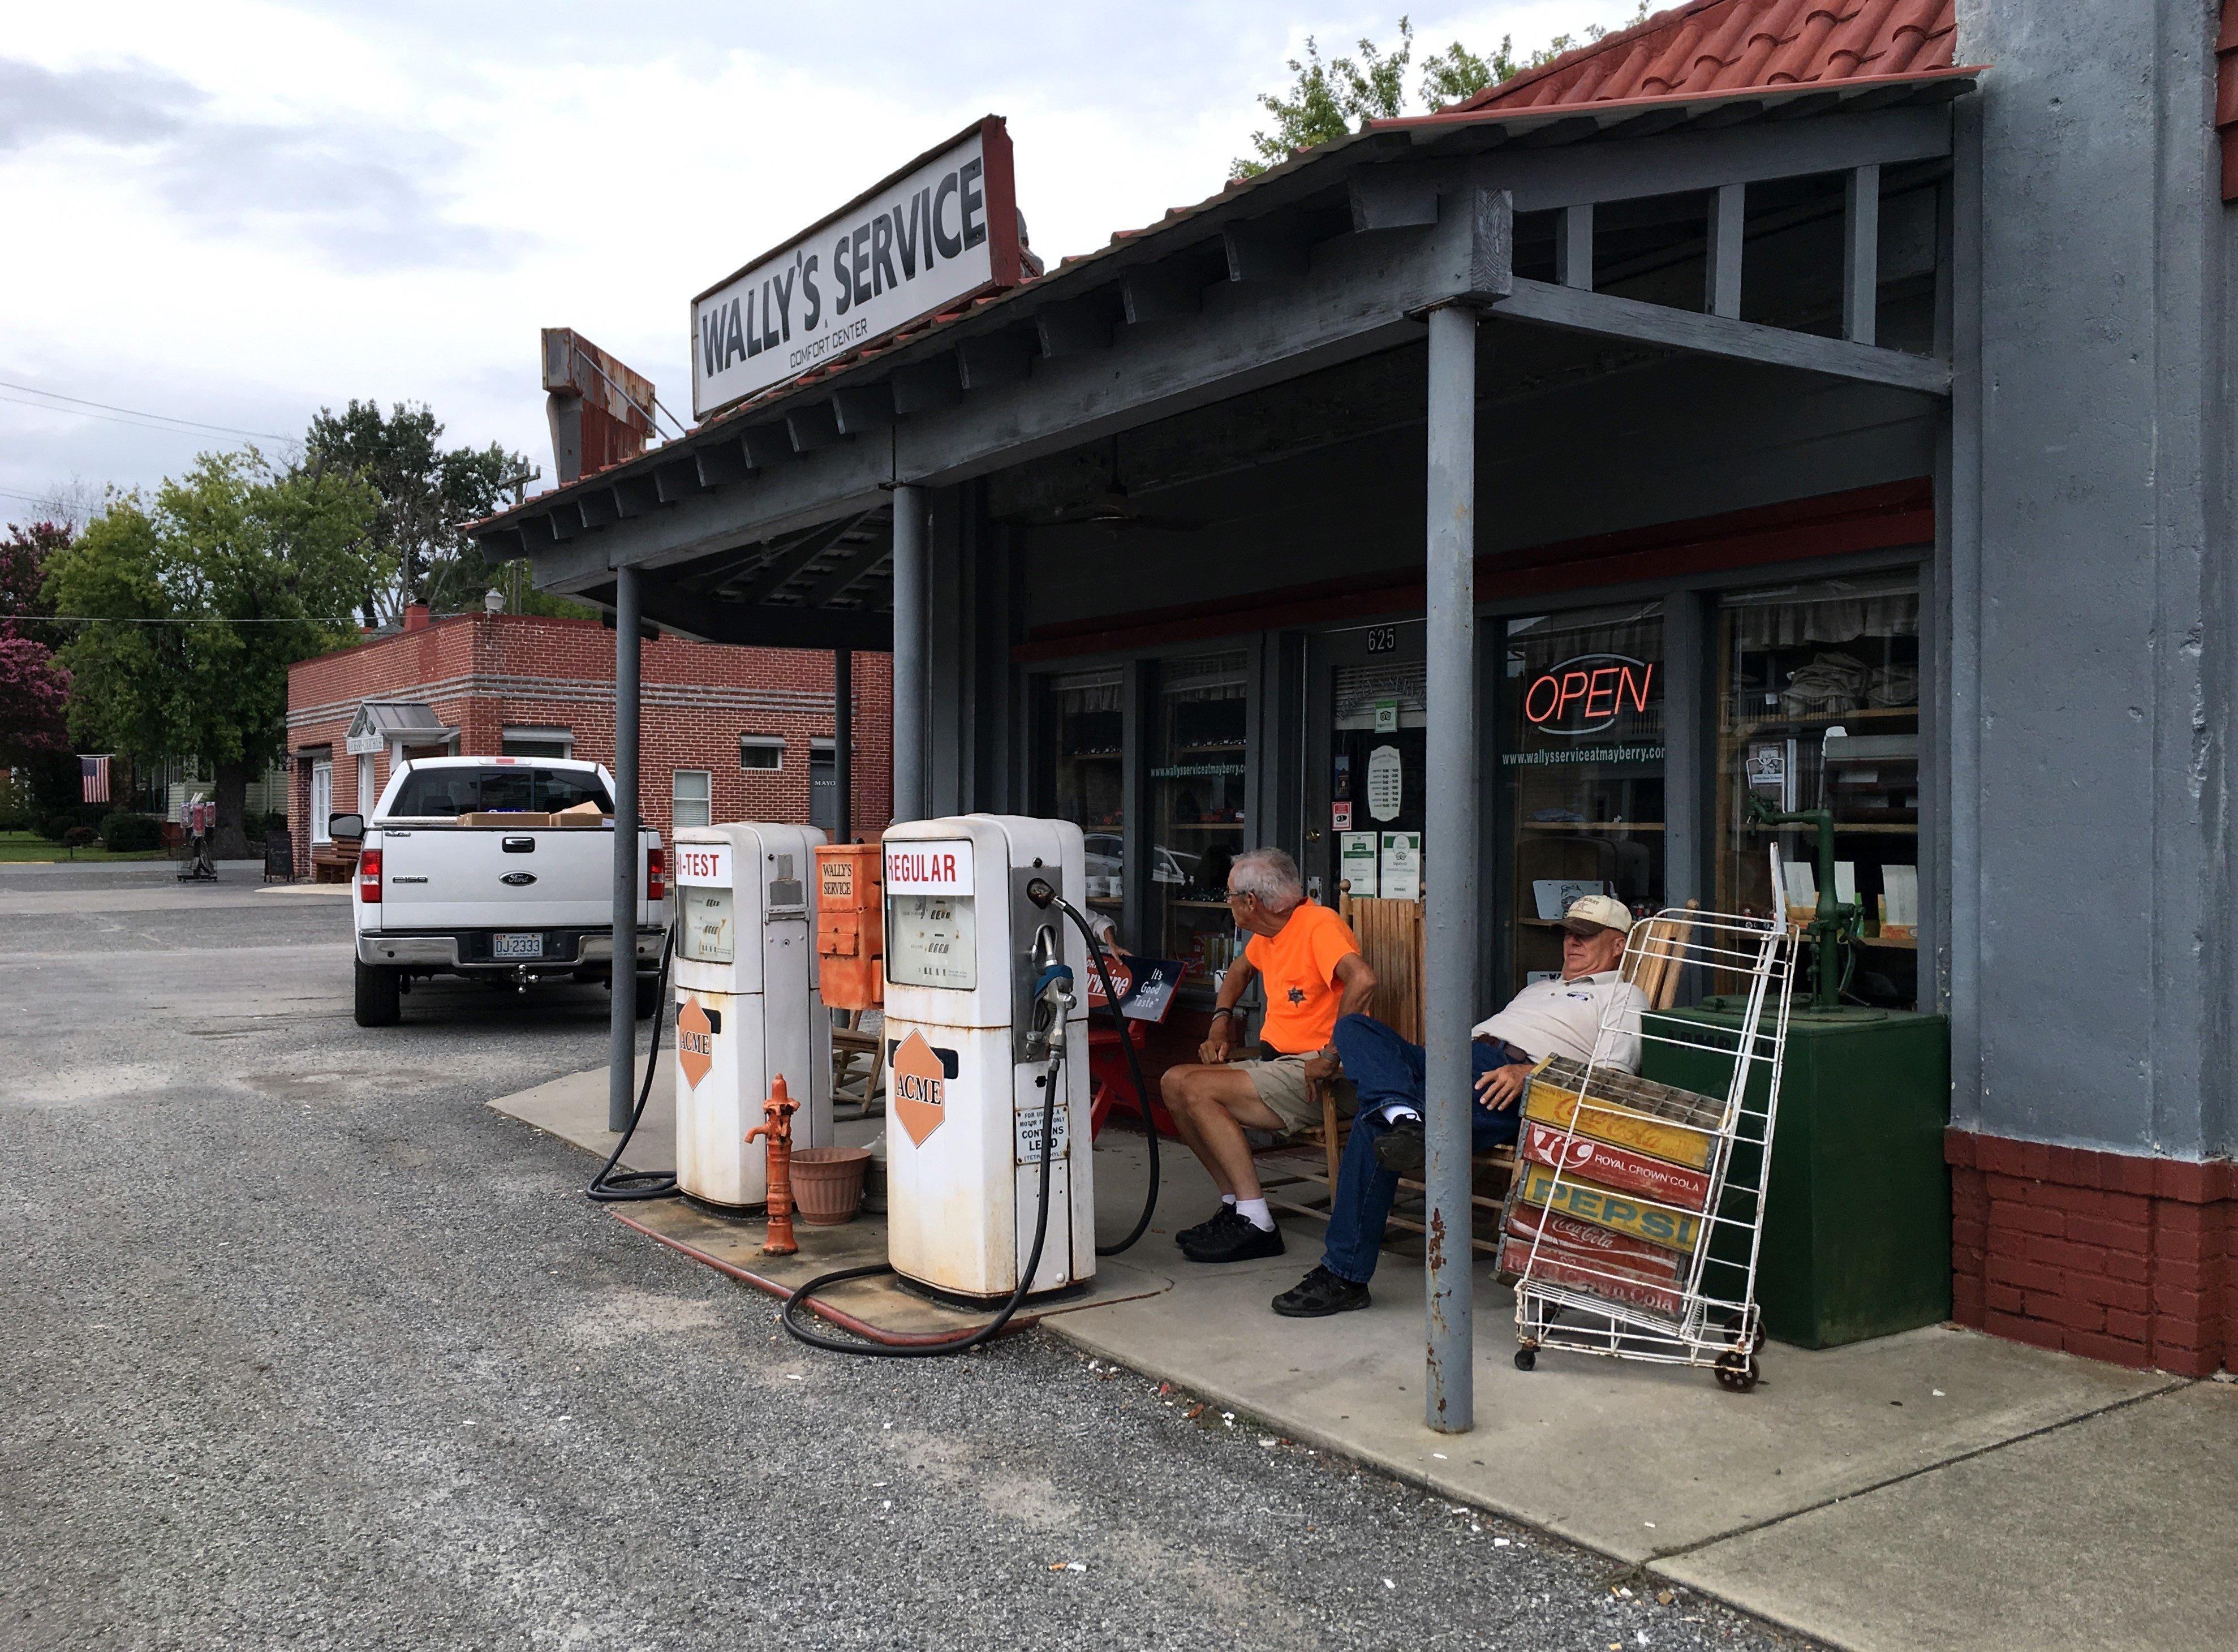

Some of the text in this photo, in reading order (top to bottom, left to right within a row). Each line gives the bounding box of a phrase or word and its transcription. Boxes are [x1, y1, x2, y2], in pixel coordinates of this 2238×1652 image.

[703, 156, 987, 378] WALLY'S SERVICE
[790, 317, 868, 368] COMFORT CENTER
[1368, 628, 1395, 651] 625
[1526, 663, 1653, 723] OPEN
[1151, 762, 1245, 777] www.wallysserviceatmayberry.c
[677, 853, 720, 876] HI-TEST
[823, 863, 852, 877] WALLY'S
[888, 854, 956, 881] REGULAR
[508, 874, 528, 883] Ford
[824, 881, 851, 895] SERVICE
[496, 940, 540, 952] DJ-2333
[1151, 967, 1163, 980] It's
[1140, 981, 1162, 995] Good
[680, 1031, 710, 1055] ACME
[896, 1073, 941, 1105] ACME
[1022, 1126, 1064, 1139] CONTNS
[1029, 1138, 1058, 1151] LED
[1595, 1154, 1699, 1191] ROYAL CROWN COLA
[1533, 1178, 1692, 1244] PEPSI
[1552, 1216, 1617, 1248] Coca-Cola
[1630, 1287, 1673, 1312] Cola
